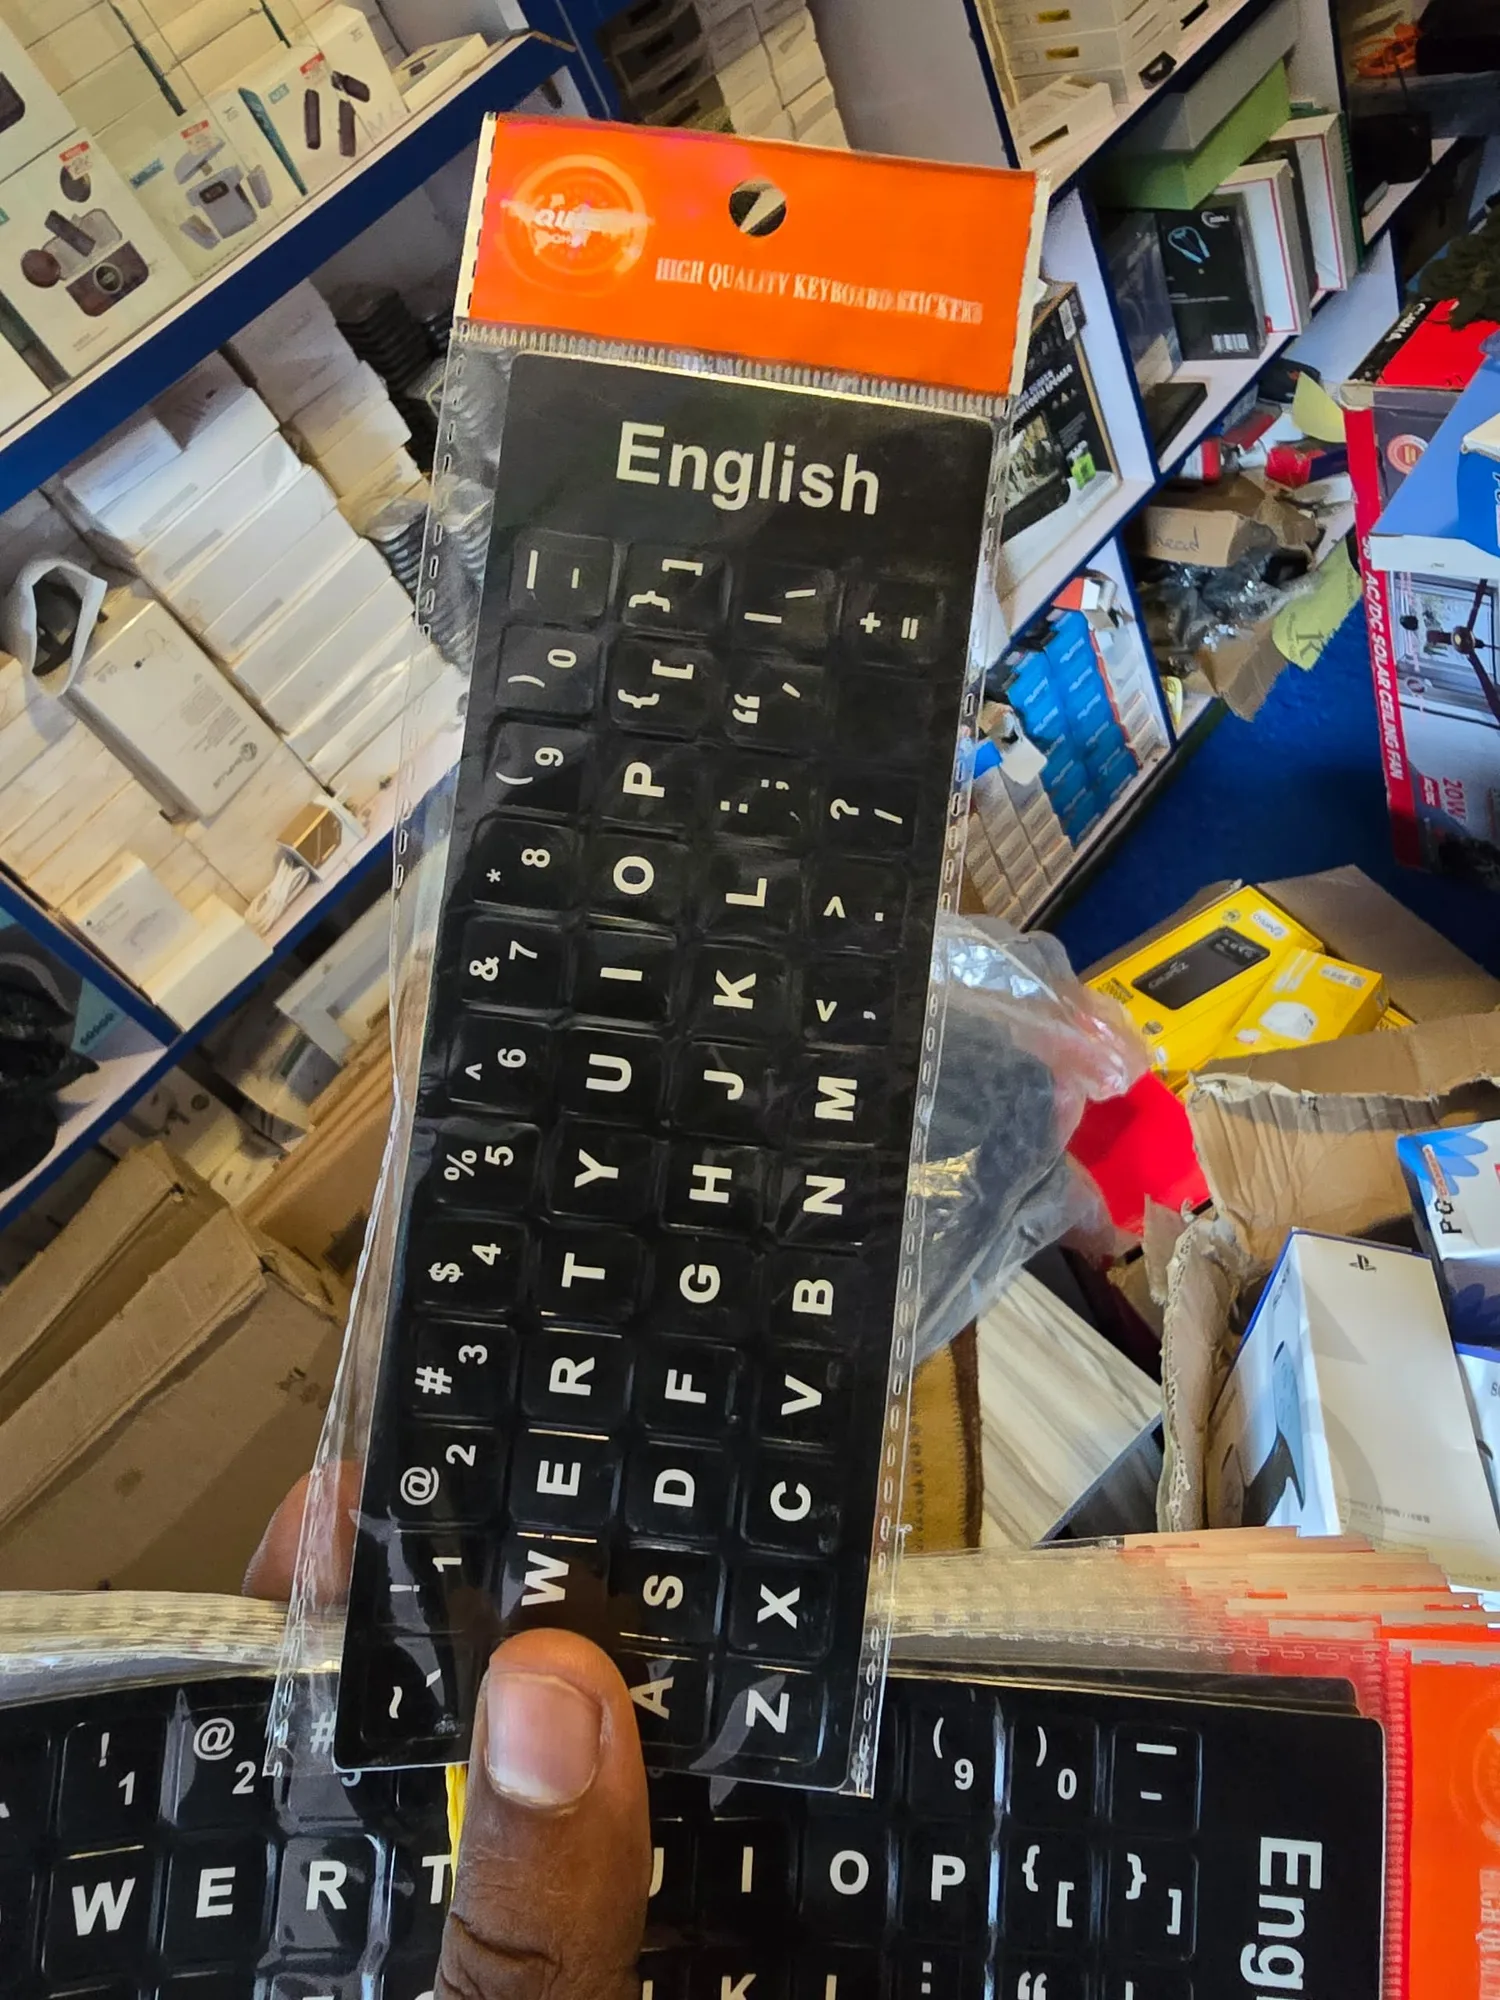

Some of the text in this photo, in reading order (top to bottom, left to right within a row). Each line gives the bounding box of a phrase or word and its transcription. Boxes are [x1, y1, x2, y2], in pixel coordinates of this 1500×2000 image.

[655, 257, 704, 285] HIGH
[707, 262, 790, 297] QUALITY
[793, 273, 895, 312] KEYBOARD
[616, 421, 879, 515] English
[1365, 571, 1384, 634] AC/DC
[548, 649, 576, 667] 0
[1371, 634, 1391, 692] SOLAR
[1378, 689, 1400, 750] CEILING
[535, 748, 563, 766] 9
[1387, 748, 1404, 780] FAN
[623, 762, 664, 797] P
[830, 799, 859, 819] ?
[1442, 777, 1467, 821] 20W
[522, 849, 550, 867] 8
[614, 856, 654, 894] O
[726, 878, 767, 906] L
[470, 941, 537, 981] & 7
[713, 970, 756, 1009] K
[498, 1049, 526, 1067] 6
[586, 1054, 631, 1091] U
[704, 1070, 744, 1100] J
[815, 1077, 857, 1121] M
[444, 1146, 513, 1180] % 5
[575, 1149, 618, 1187] Y
[690, 1165, 732, 1203] H
[803, 1175, 845, 1215] N
[428, 1244, 501, 1282] $ 4
[562, 1253, 605, 1287] T
[680, 1264, 720, 1303] G
[792, 1280, 833, 1315] B
[415, 1345, 487, 1394] # 3
[549, 1358, 594, 1395] R
[665, 1370, 706, 1403] F
[781, 1375, 821, 1415] V
[401, 1445, 476, 1505] @ 2
[537, 1461, 580, 1496] E
[654, 1469, 694, 1507] D
[770, 1482, 811, 1521] C
[433, 1557, 462, 1572] 1
[522, 1550, 569, 1606] W
[643, 1576, 683, 1609] S
[758, 1585, 800, 1628] X
[632, 1677, 674, 1720] A
[746, 1689, 789, 1733] Z
[193, 1718, 255, 1794] @ 2
[955, 1759, 973, 1789] 9
[119, 1772, 134, 1805] 1
[1058, 1769, 1076, 1799] 0
[306, 1861, 347, 1910] R
[422, 1855, 452, 1904] T
[830, 1851, 869, 1894] O
[931, 1855, 965, 1901] P
[72, 1878, 135, 1935] W
[196, 1867, 235, 1918] E
